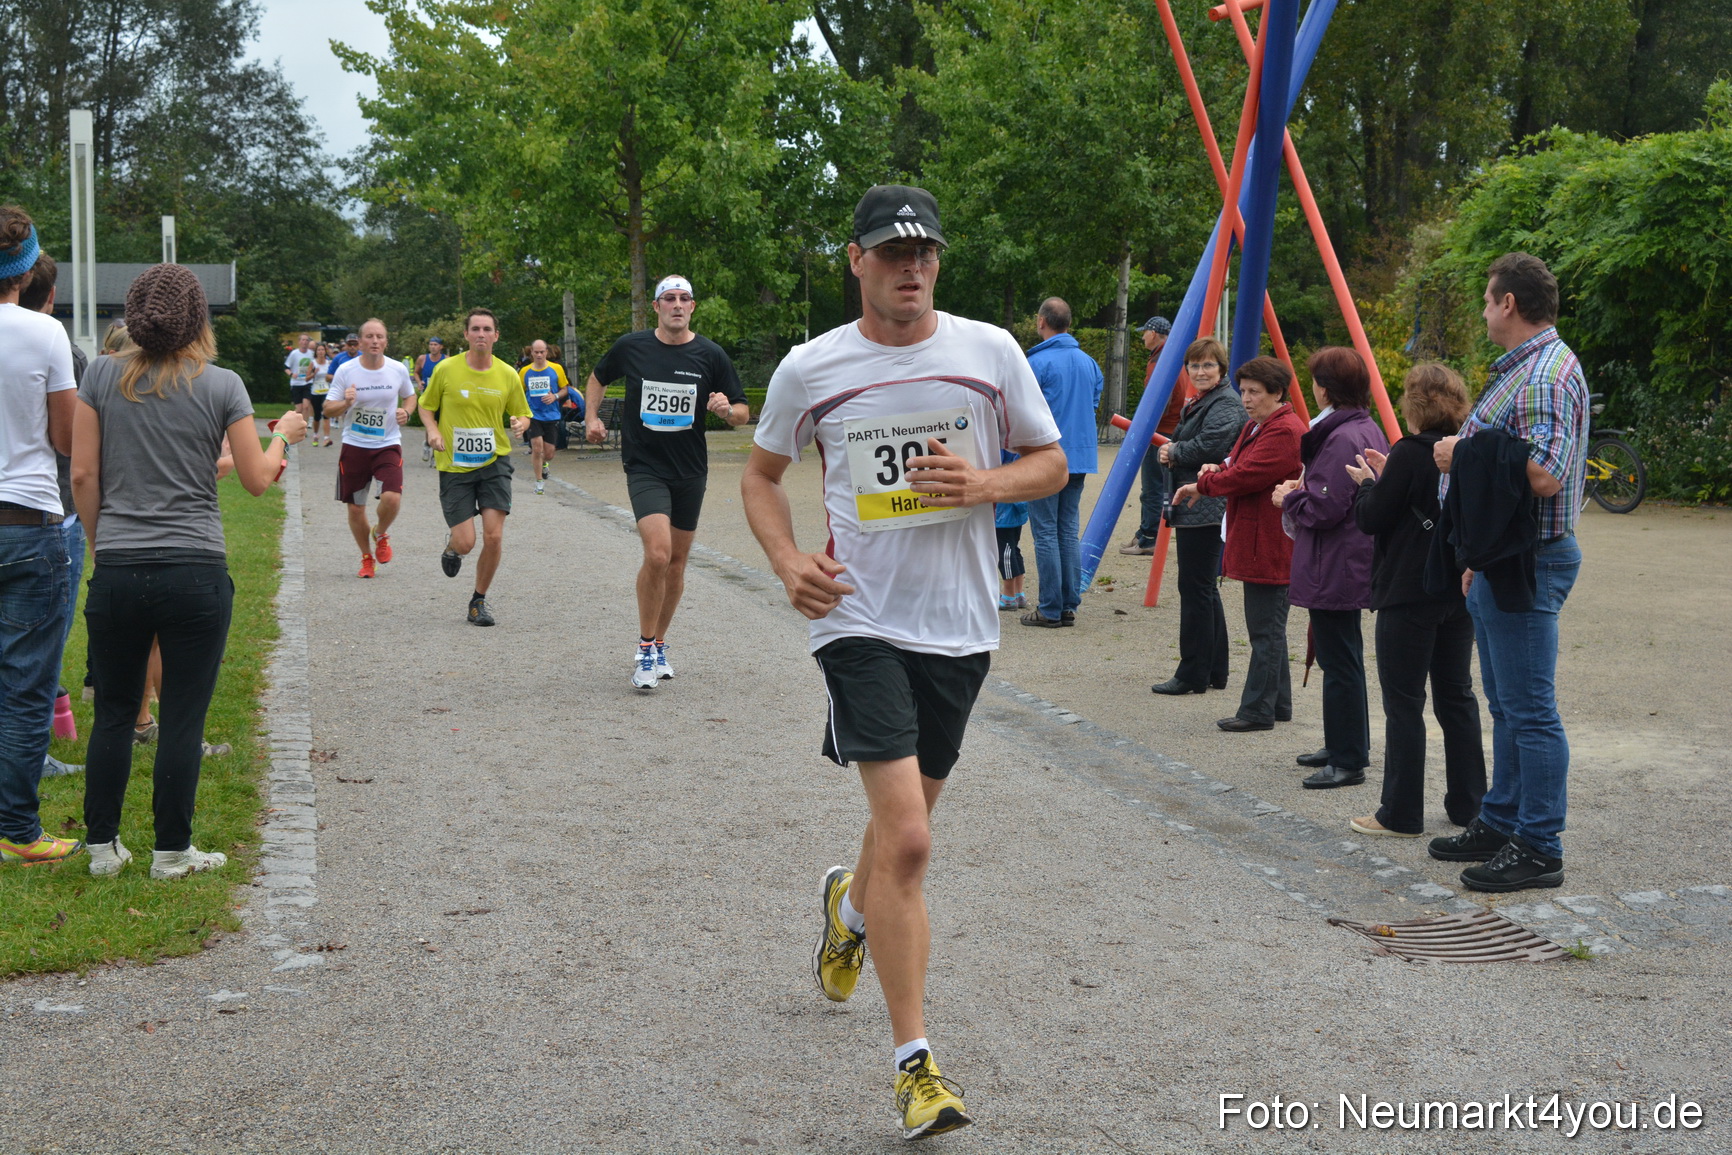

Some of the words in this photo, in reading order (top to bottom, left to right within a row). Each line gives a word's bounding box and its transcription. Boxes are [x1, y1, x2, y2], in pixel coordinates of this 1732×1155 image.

[530, 381, 549, 390] 2826
[643, 385, 661, 393] PARTL
[647, 393, 691, 414] 2596
[355, 411, 384, 427] 2563
[658, 417, 675, 425] Jens
[847, 429, 890, 443] PARTL
[892, 421, 950, 437] Neumarkt
[457, 437, 493, 452] 2035
